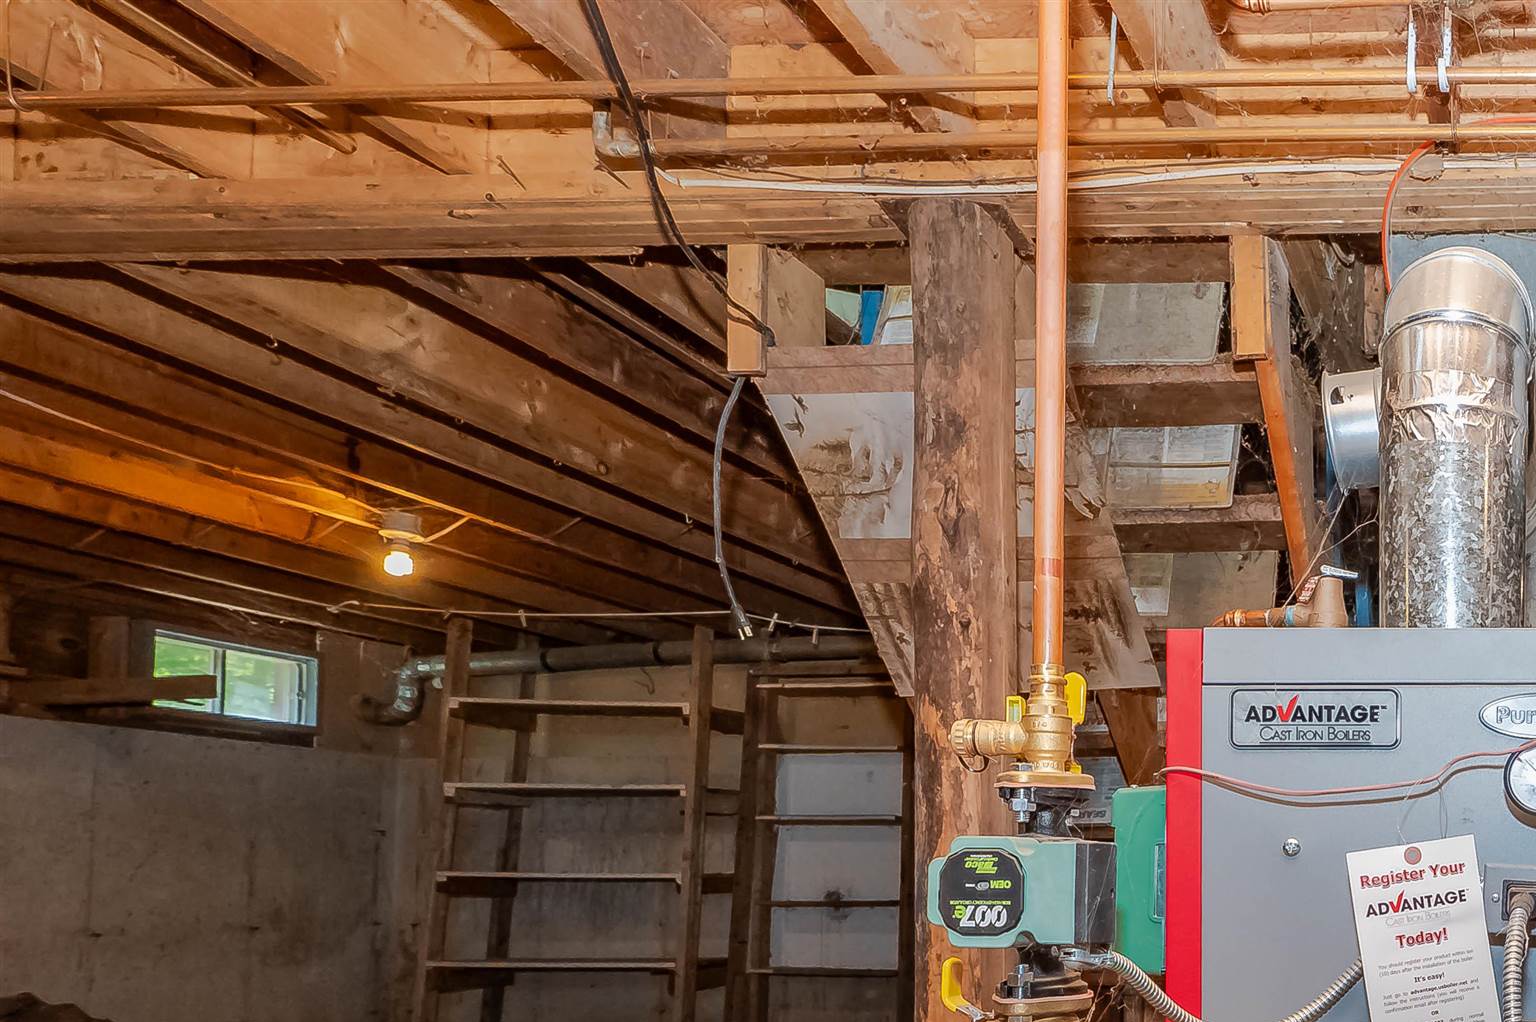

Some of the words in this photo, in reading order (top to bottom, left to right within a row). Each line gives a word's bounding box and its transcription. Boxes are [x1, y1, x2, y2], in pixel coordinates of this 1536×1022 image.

[1244, 694, 1380, 723] ADVANTAGE
[989, 880, 1012, 889] OEM
[1360, 868, 1426, 889] Register
[1428, 862, 1466, 878] Your
[1366, 889, 1467, 918] ADVANTAGE
[1395, 927, 1448, 949] Today!
[1413, 975, 1425, 983] It's
[1426, 972, 1445, 981] easy!
